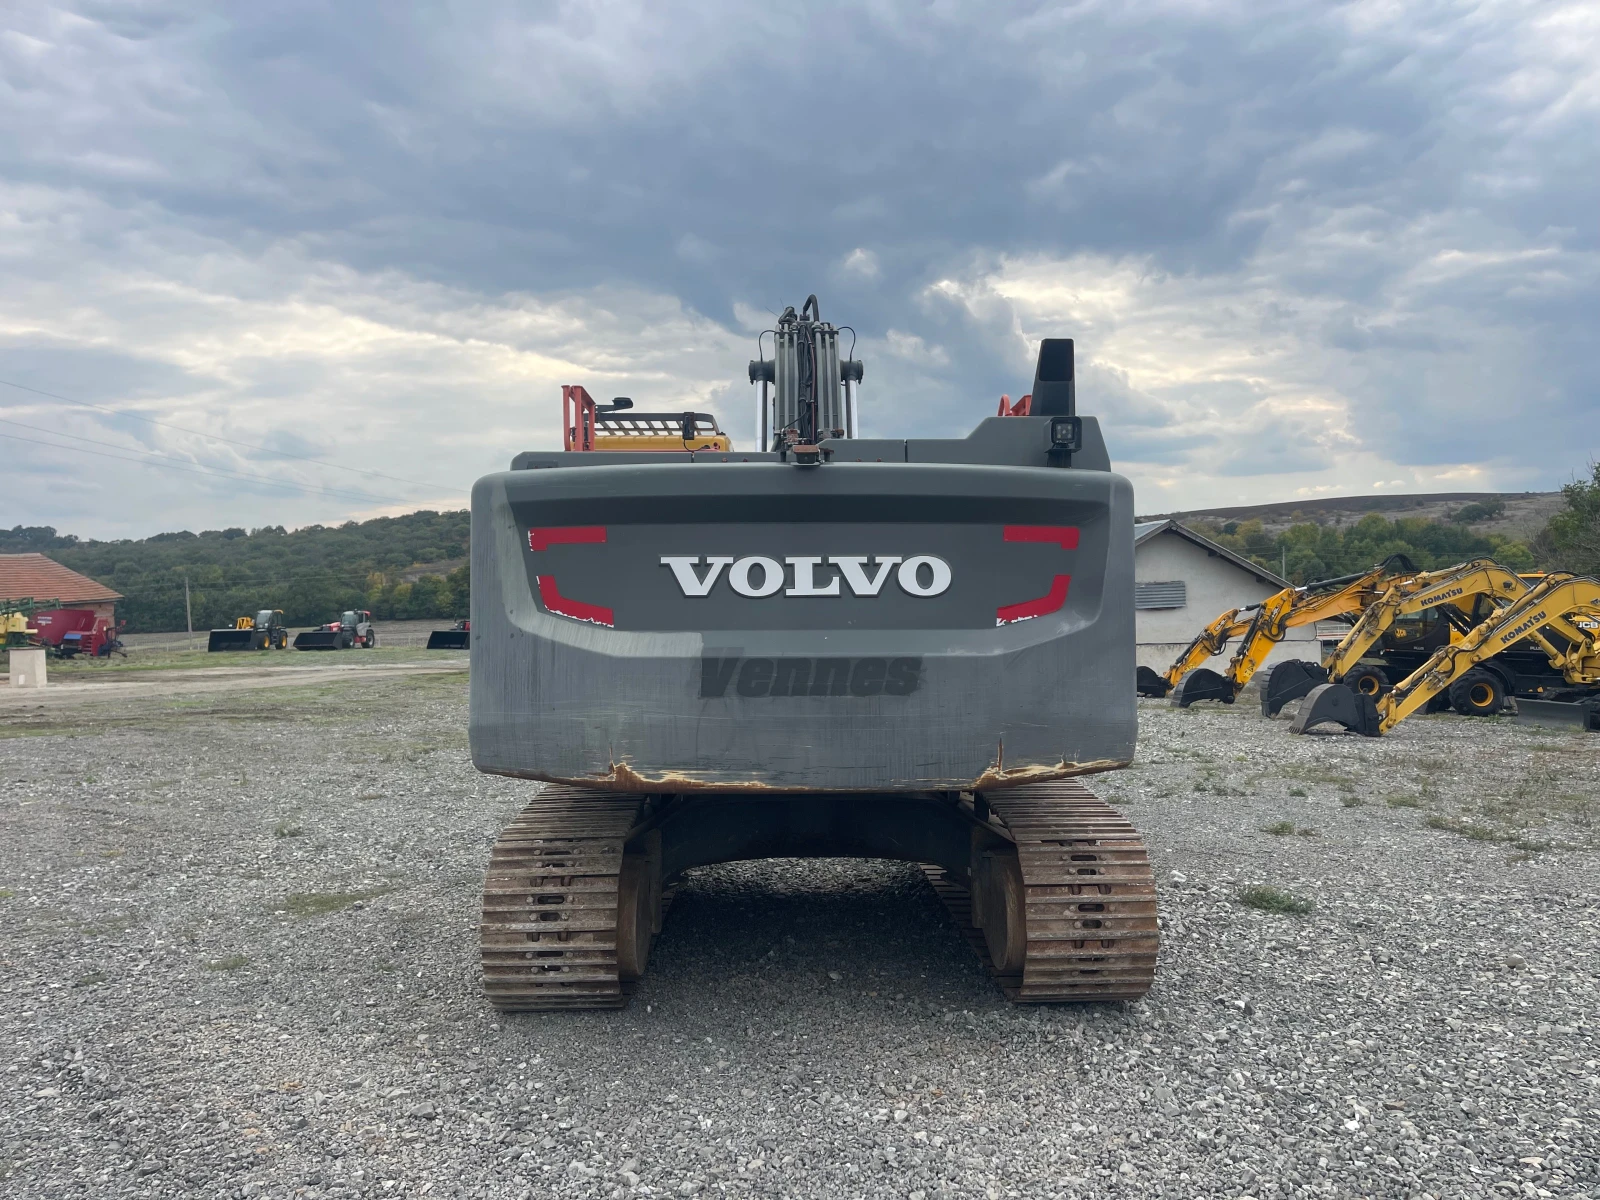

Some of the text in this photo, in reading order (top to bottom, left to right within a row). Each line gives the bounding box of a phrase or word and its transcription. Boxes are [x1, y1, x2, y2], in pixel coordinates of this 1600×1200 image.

[660, 555, 952, 598] VOLVO
[1421, 588, 1463, 606] KOMATSU
[1500, 611, 1547, 644] KOMATSU
[1578, 621, 1599, 629] JCB
[698, 647, 923, 697] Vennes
